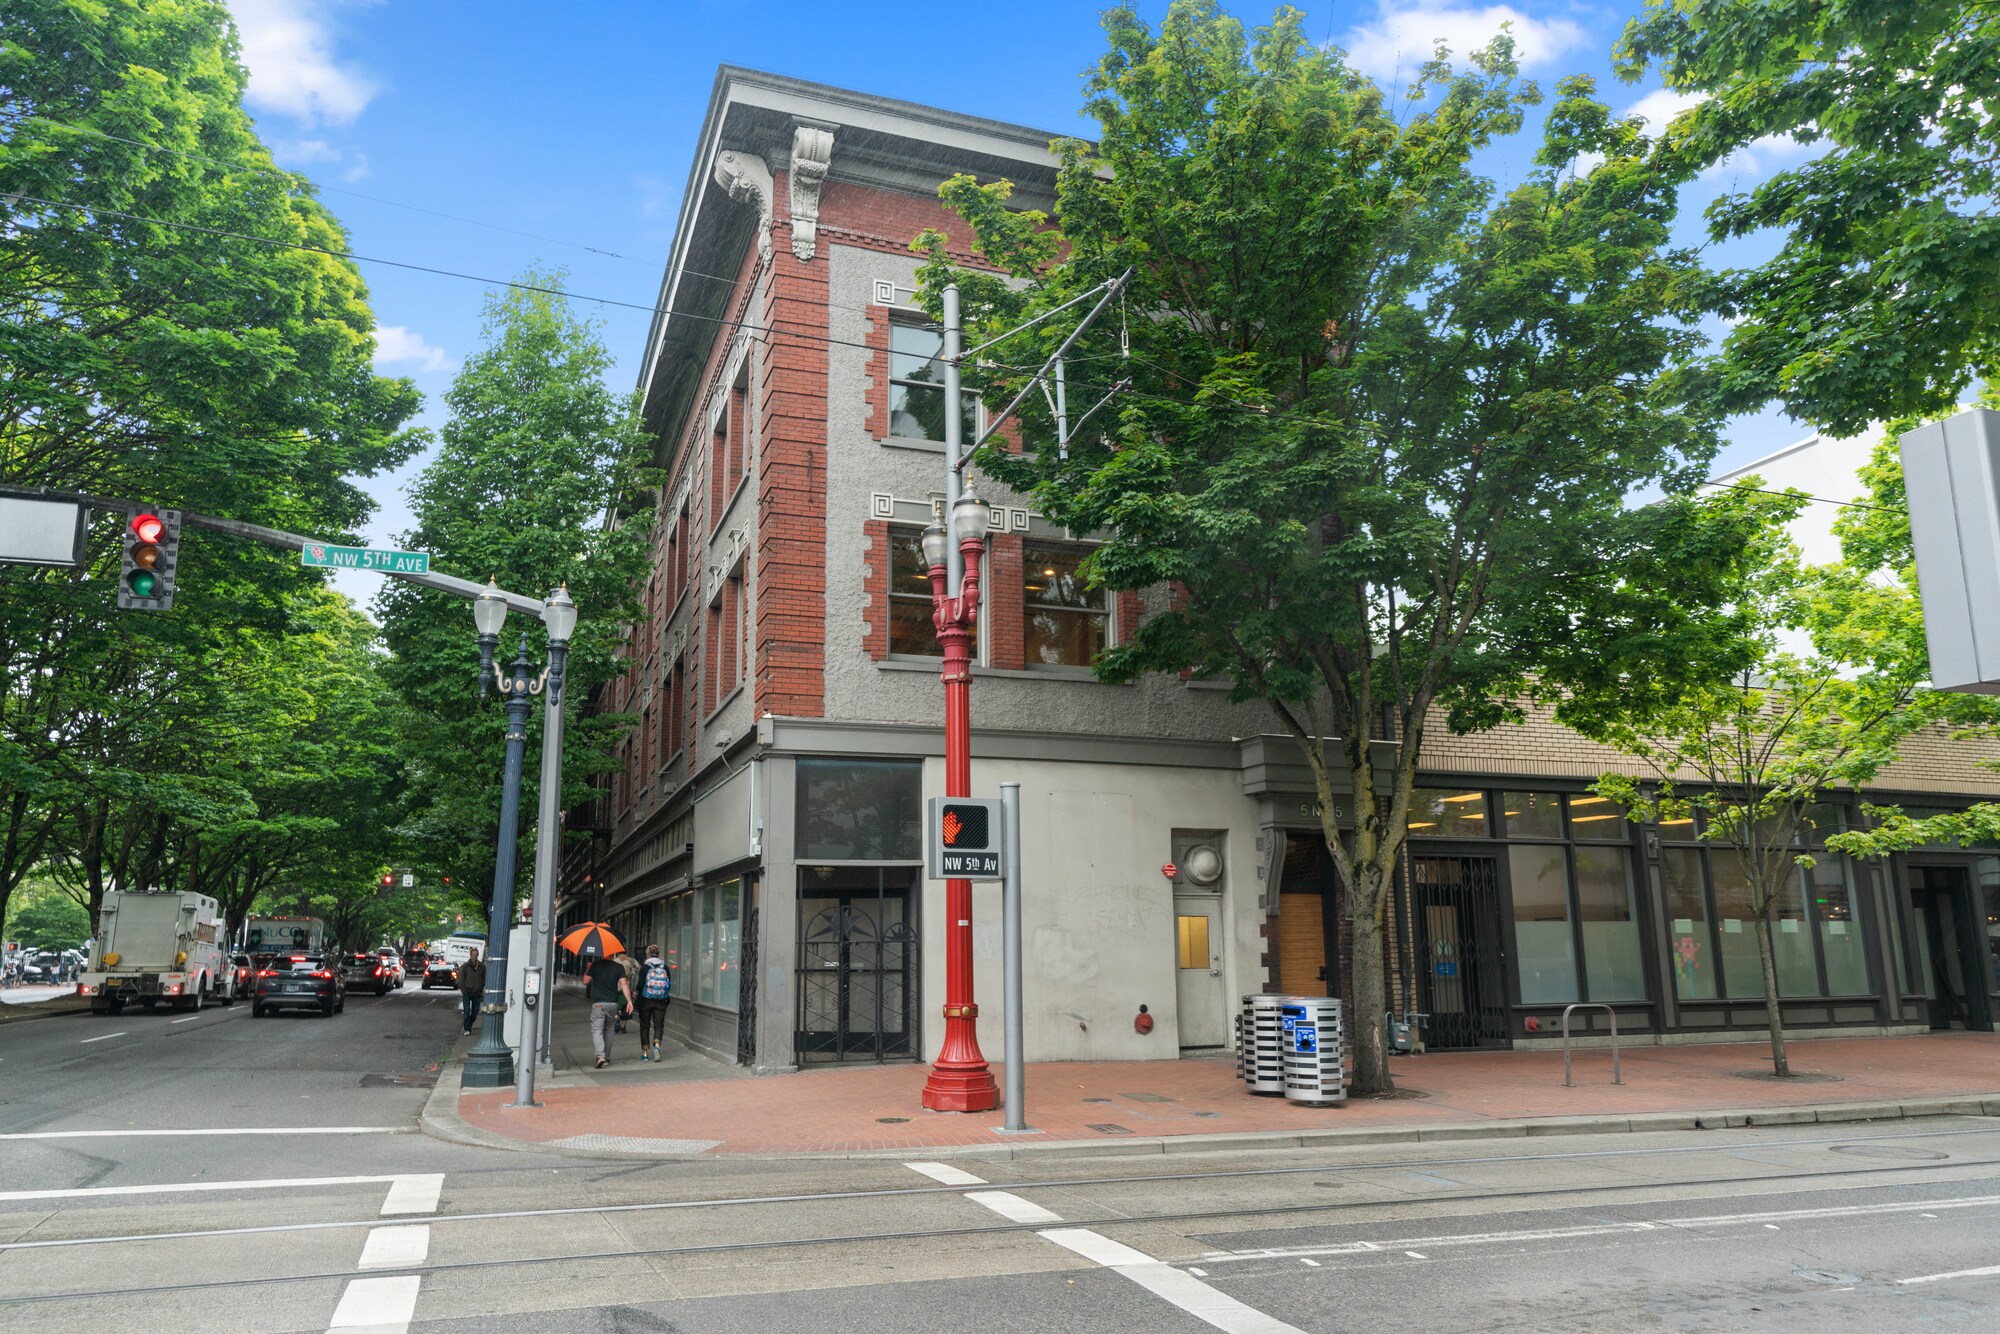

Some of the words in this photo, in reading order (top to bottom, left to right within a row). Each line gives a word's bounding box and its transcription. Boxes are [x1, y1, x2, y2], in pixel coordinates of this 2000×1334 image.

[333, 552, 358, 566] NW
[363, 551, 392, 568] 5TH
[396, 557, 423, 572] AVE
[1301, 804, 1308, 816] 5
[944, 857, 962, 871] NW
[965, 857, 980, 871] 5th
[984, 857, 997, 871] Av
